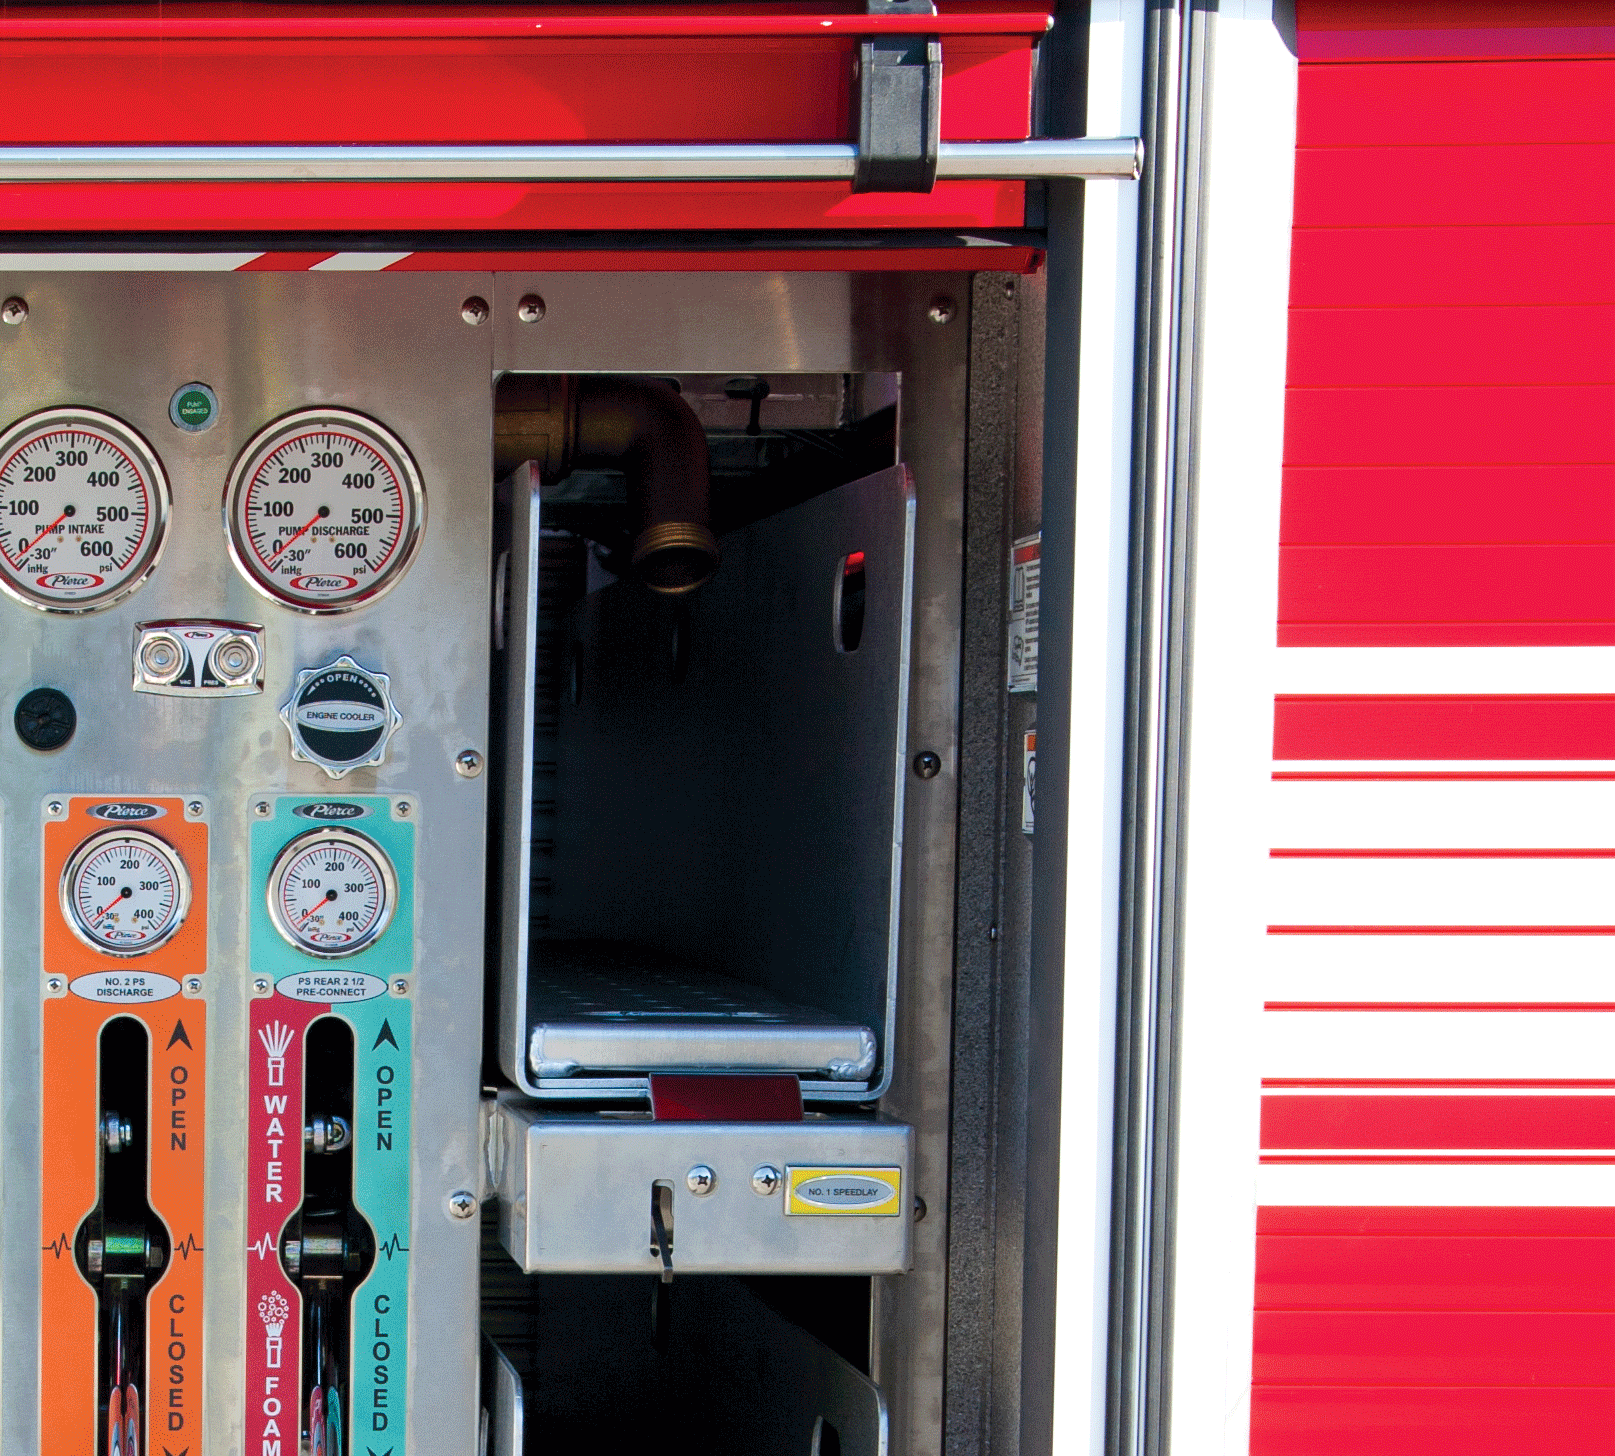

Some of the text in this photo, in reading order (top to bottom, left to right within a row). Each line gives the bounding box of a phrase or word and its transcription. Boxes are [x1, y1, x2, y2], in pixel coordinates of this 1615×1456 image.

[55, 451, 87, 466] 300
[311, 452, 343, 467] 300
[23, 467, 55, 482] 200
[87, 472, 119, 487] 400
[278, 468, 311, 483] 200
[342, 473, 374, 488] 400
[9, 500, 39, 515] 100
[97, 506, 128, 521] 500
[264, 502, 293, 516] 100
[352, 509, 383, 523] 500
[36, 525, 104, 534] PUMP INTAKE
[81, 541, 113, 556] 600
[335, 543, 367, 558] 600
[28, 564, 48, 574] inHg
[100, 564, 112, 573] psi
[282, 566, 301, 576] inHg
[353, 566, 366, 575] psi
[52, 575, 88, 586] Pierce
[305, 577, 341, 588] Pierce
[327, 673, 358, 683] OPEN
[307, 711, 374, 721] ENGINE COOLER
[103, 803, 148, 819] Pierce
[310, 803, 355, 819] Pierce
[325, 862, 344, 871] 200
[302, 879, 320, 888] 100
[345, 884, 363, 892] 300
[339, 912, 359, 920] 400
[105, 977, 145, 986] NO. 2 PS
[298, 977, 365, 985] PS REAR 2 1/2
[96, 988, 153, 997] DISCHARGE
[296, 988, 366, 997] PRE-CONNECT
[170, 1066, 188, 1151] OPEN
[376, 1066, 394, 1151] OPEN
[264, 1096, 287, 1202] WATER
[808, 1188, 878, 1197] NO. 1 SPEEDLAY
[168, 1295, 185, 1431] CLOSED
[373, 1295, 390, 1431] CLOSED
